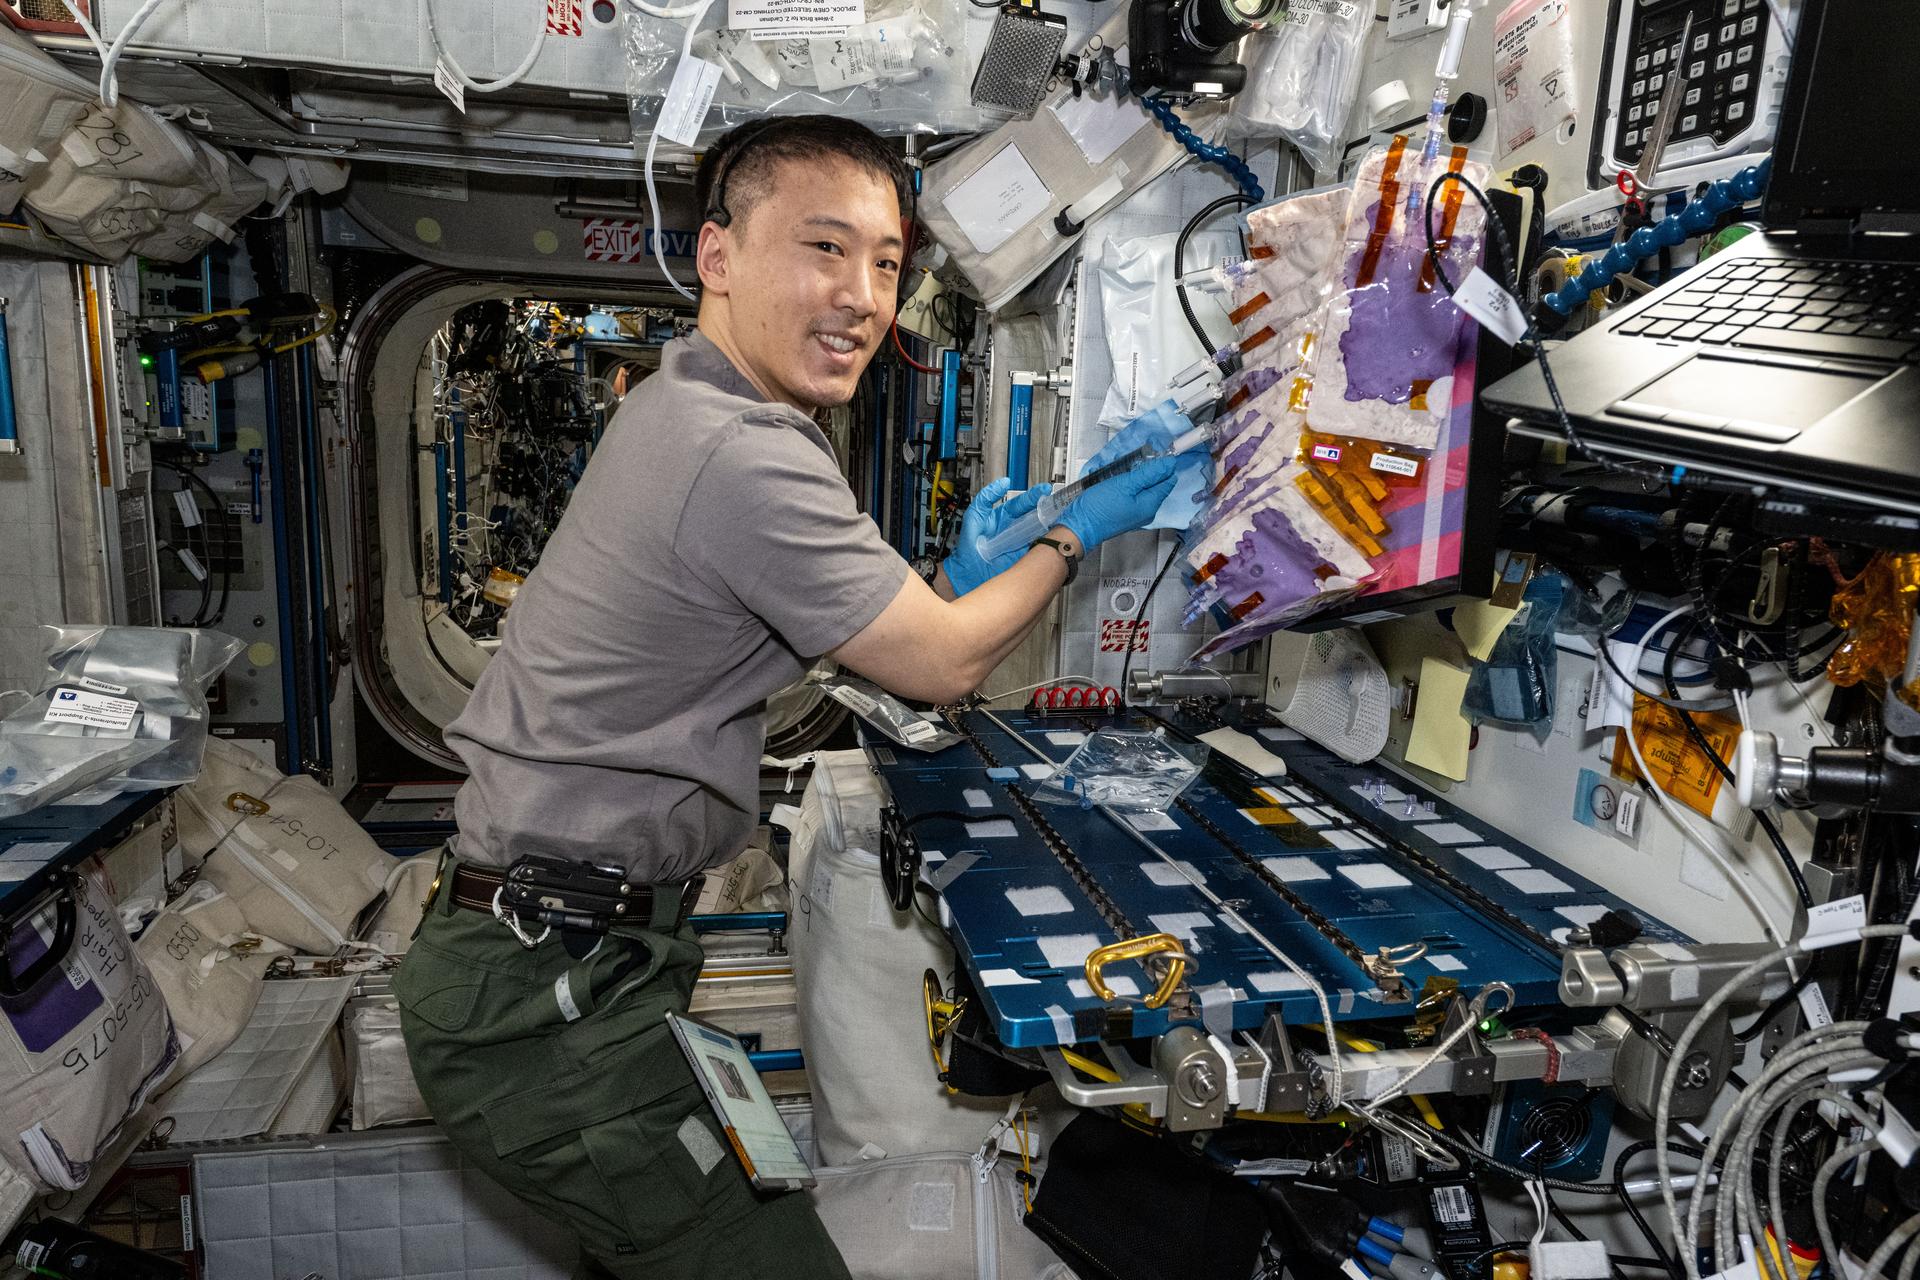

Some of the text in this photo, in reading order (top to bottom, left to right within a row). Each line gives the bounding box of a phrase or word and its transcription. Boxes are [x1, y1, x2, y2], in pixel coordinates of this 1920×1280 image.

[558, 2, 566, 21] PORT
[592, 228, 631, 253] EXIT
[58, 711, 83, 719] Support
